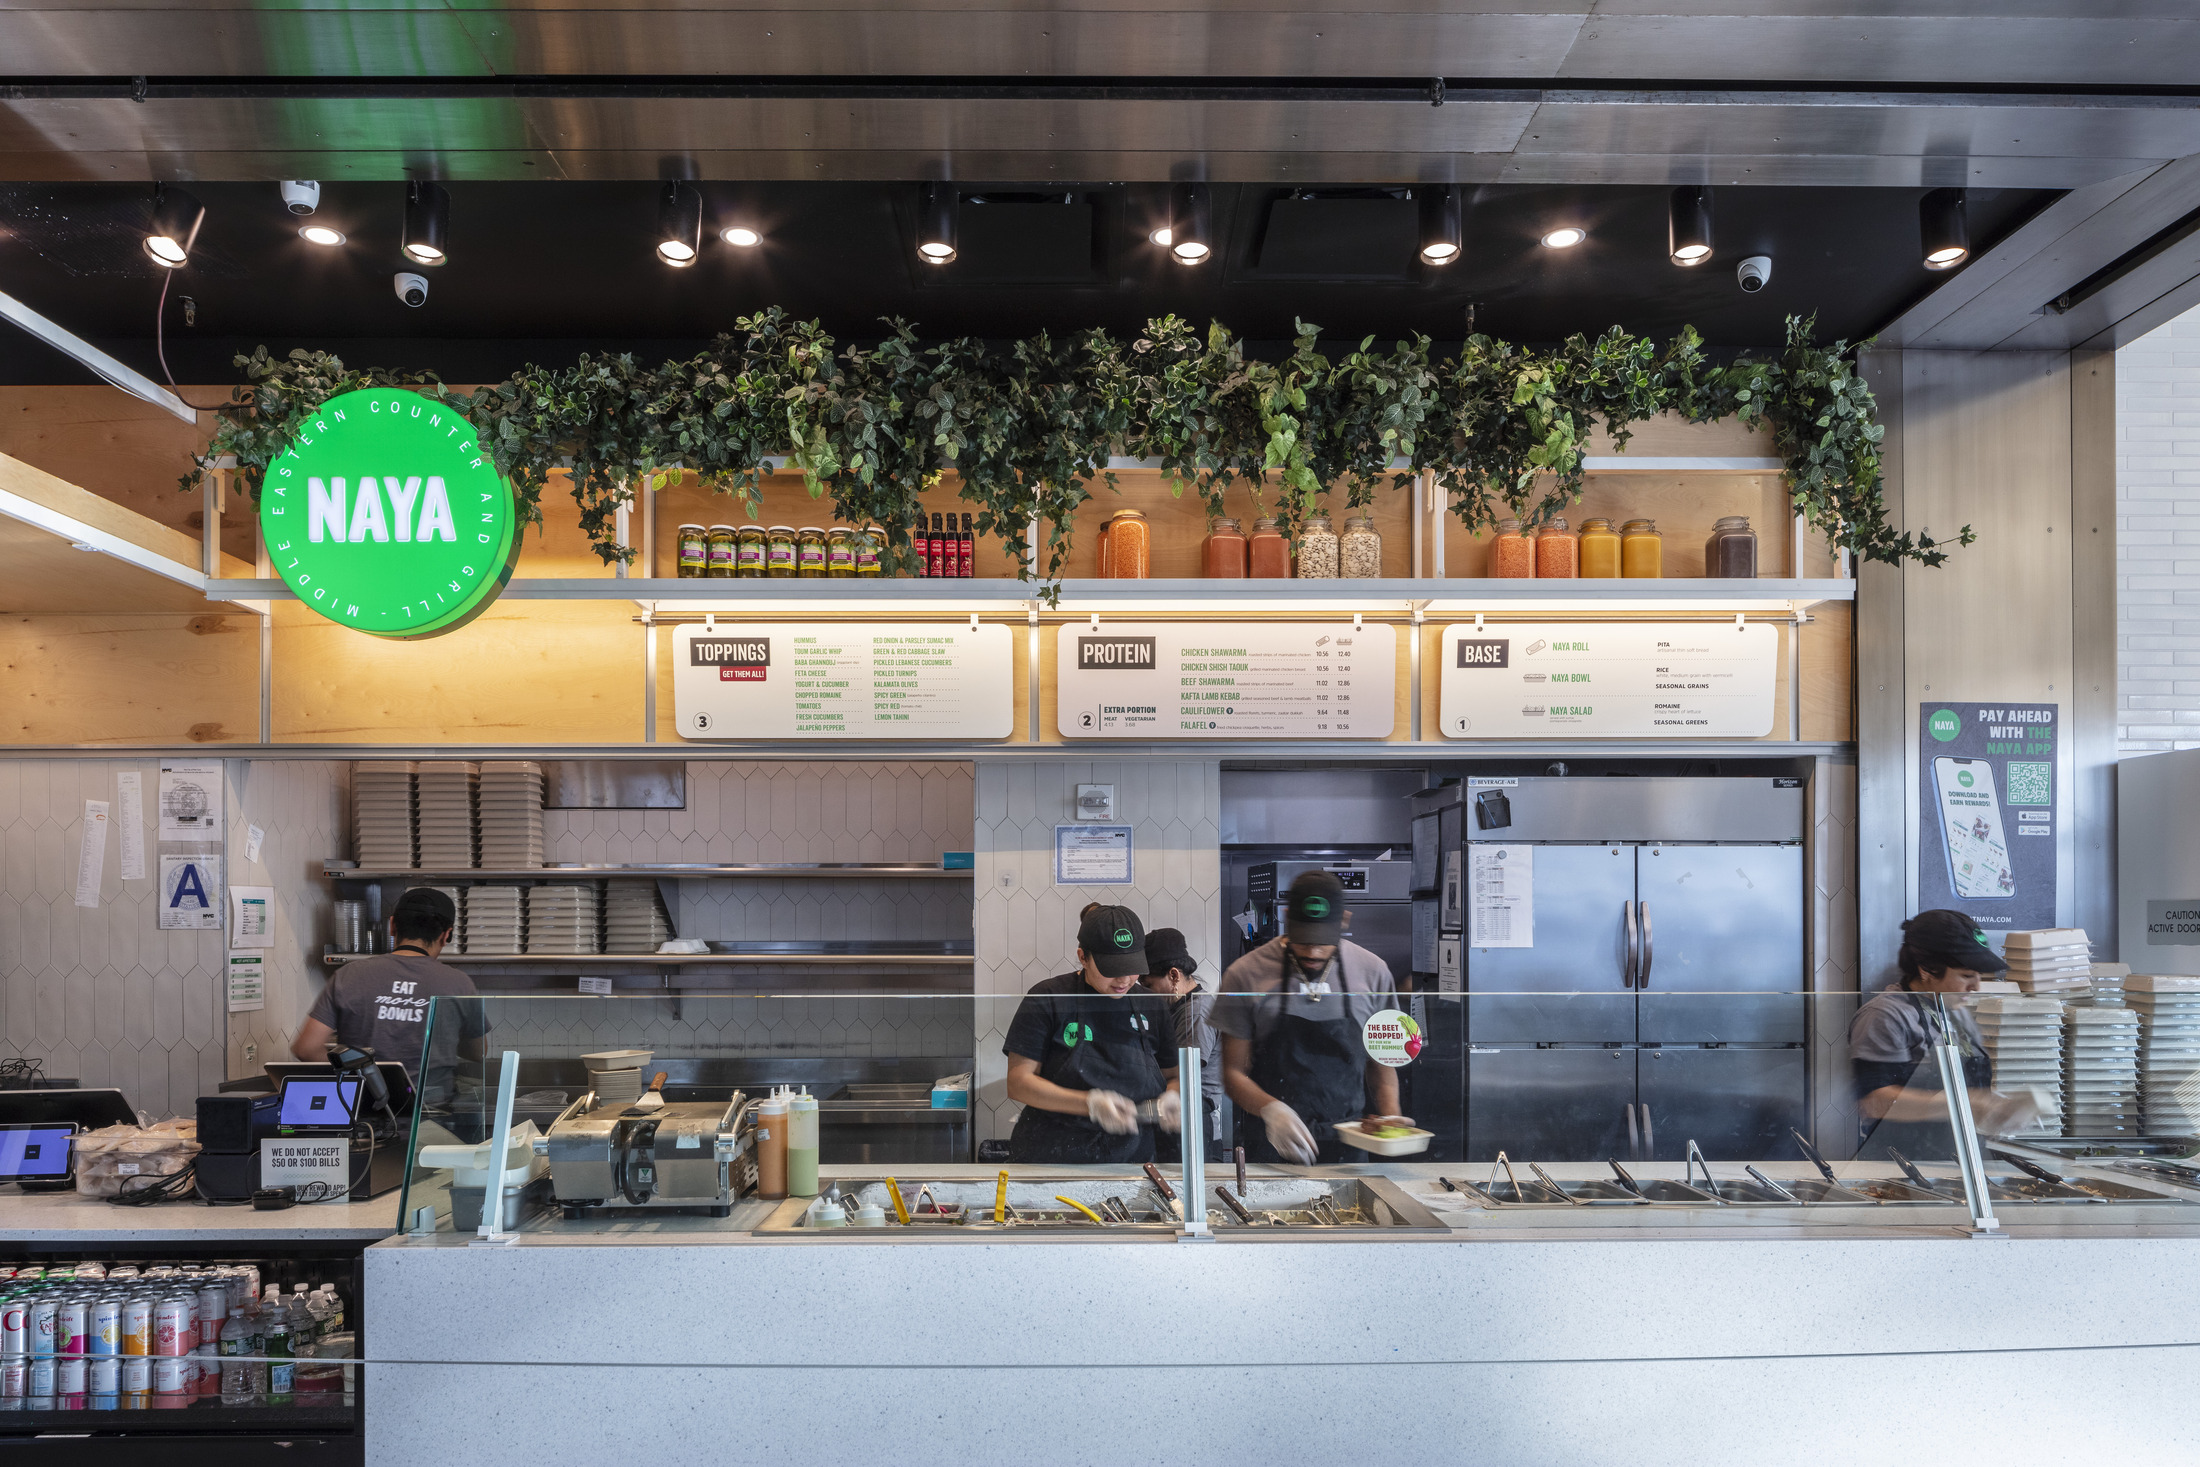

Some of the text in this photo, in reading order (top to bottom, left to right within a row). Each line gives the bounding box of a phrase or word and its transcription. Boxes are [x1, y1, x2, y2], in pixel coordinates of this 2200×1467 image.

[272, 401, 493, 618] MIDDLE EASTERN COUNTER AND GRILL
[308, 476, 457, 543] NAYA
[1552, 642, 1589, 651] NAYA ROLL
[696, 643, 767, 662] TOPPINGS
[1083, 643, 1150, 664] PROTEIN
[1181, 649, 1209, 657] CHICKEN
[1210, 649, 1247, 657] SHAWARMA
[1465, 645, 1501, 663] BASE
[1181, 663, 1208, 671] CHICKEN
[1208, 663, 1227, 671] SHISH
[1228, 663, 1249, 671] TAOUK
[1181, 678, 1197, 686] BEEF
[1197, 678, 1235, 686] SHAWARMA
[1551, 674, 1591, 682] NAYA BOWL
[1181, 692, 1200, 700] KAFTA
[1201, 692, 1219, 700] LAMB
[1220, 692, 1240, 700] KEBAB
[1181, 707, 1225, 715] CAULIFLOWER
[1550, 706, 1592, 716] NAYA SALAD
[1083, 715, 1091, 726] 2
[1979, 710, 2051, 723] PAY AHEAD
[698, 716, 707, 728] 3
[1181, 721, 1207, 729] FALAFEL
[1459, 719, 1465, 729] 1
[1934, 720, 1954, 730] NAYA
[1990, 726, 2051, 739] WITH THE
[1986, 743, 2051, 755] NAYA APP
[170, 864, 210, 908] A
[2166, 911, 2200, 920] CAUTION
[2148, 924, 2174, 932] ACTIVE
[1116, 934, 1130, 942] NAYA
[392, 981, 418, 994] EAT
[374, 996, 430, 1007] more
[377, 1005, 424, 1022] BOWLS
[272, 1148, 339, 1156] WE DO NOT ACCEPT
[272, 1158, 340, 1167] $50 OR $100 BILLS
